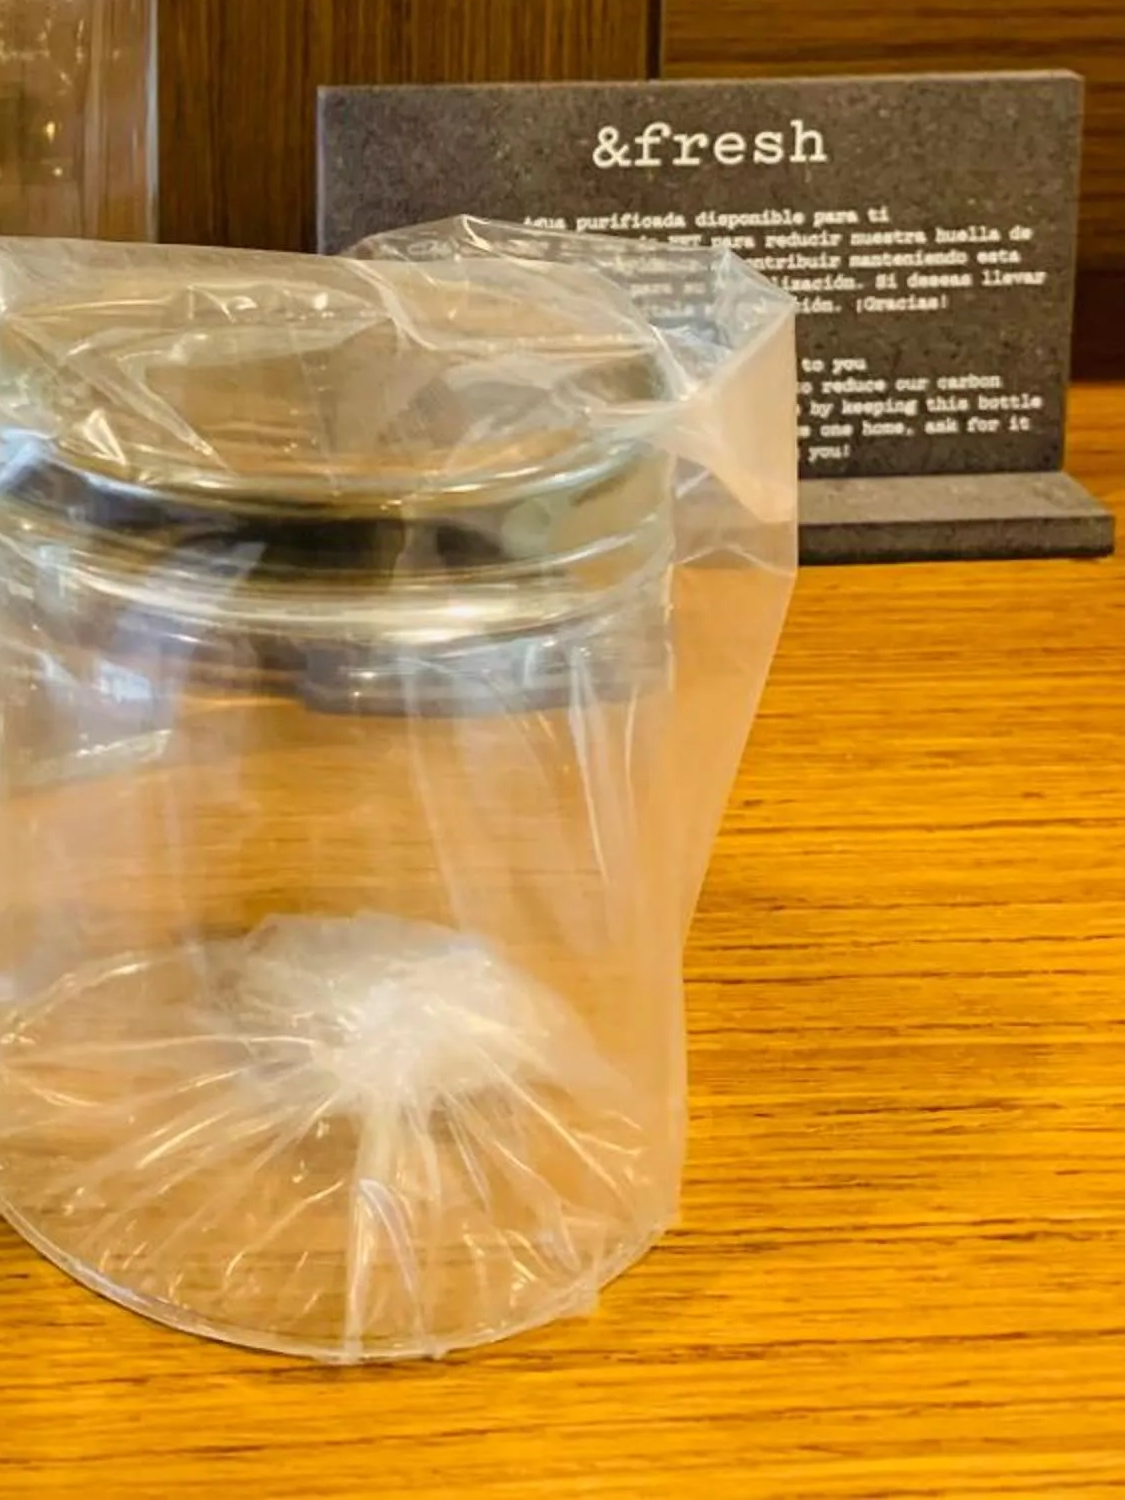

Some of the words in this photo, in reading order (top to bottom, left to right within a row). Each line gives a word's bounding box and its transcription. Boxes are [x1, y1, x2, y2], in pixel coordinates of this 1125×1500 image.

[592, 119, 828, 168] &fresh
[576, 212, 686, 233] purificada
[695, 209, 805, 229] disponible
[813, 209, 860, 227] para
[867, 206, 890, 223] ti
[765, 231, 842, 248] reducir
[850, 229, 927, 246] nuestra
[935, 226, 1001, 243] huella
[1008, 226, 1034, 241] de
[848, 250, 969, 268] manteniendo
[976, 250, 1022, 264] esta
[875, 272, 898, 289] Si
[906, 272, 973, 288] deseas
[981, 269, 1047, 286] llevar
[801, 357, 824, 372] to
[832, 357, 867, 375] you
[822, 377, 887, 394] reduce
[895, 377, 929, 391] our
[936, 374, 1003, 390] carbon
[810, 400, 834, 418] by
[841, 398, 918, 417] keeping
[926, 395, 969, 412] this
[977, 393, 1043, 410] bottle
[820, 424, 853, 437] one
[924, 418, 959, 434] ask
[966, 416, 1001, 432] for
[1008, 416, 1031, 431] it
[808, 444, 851, 463] you!
